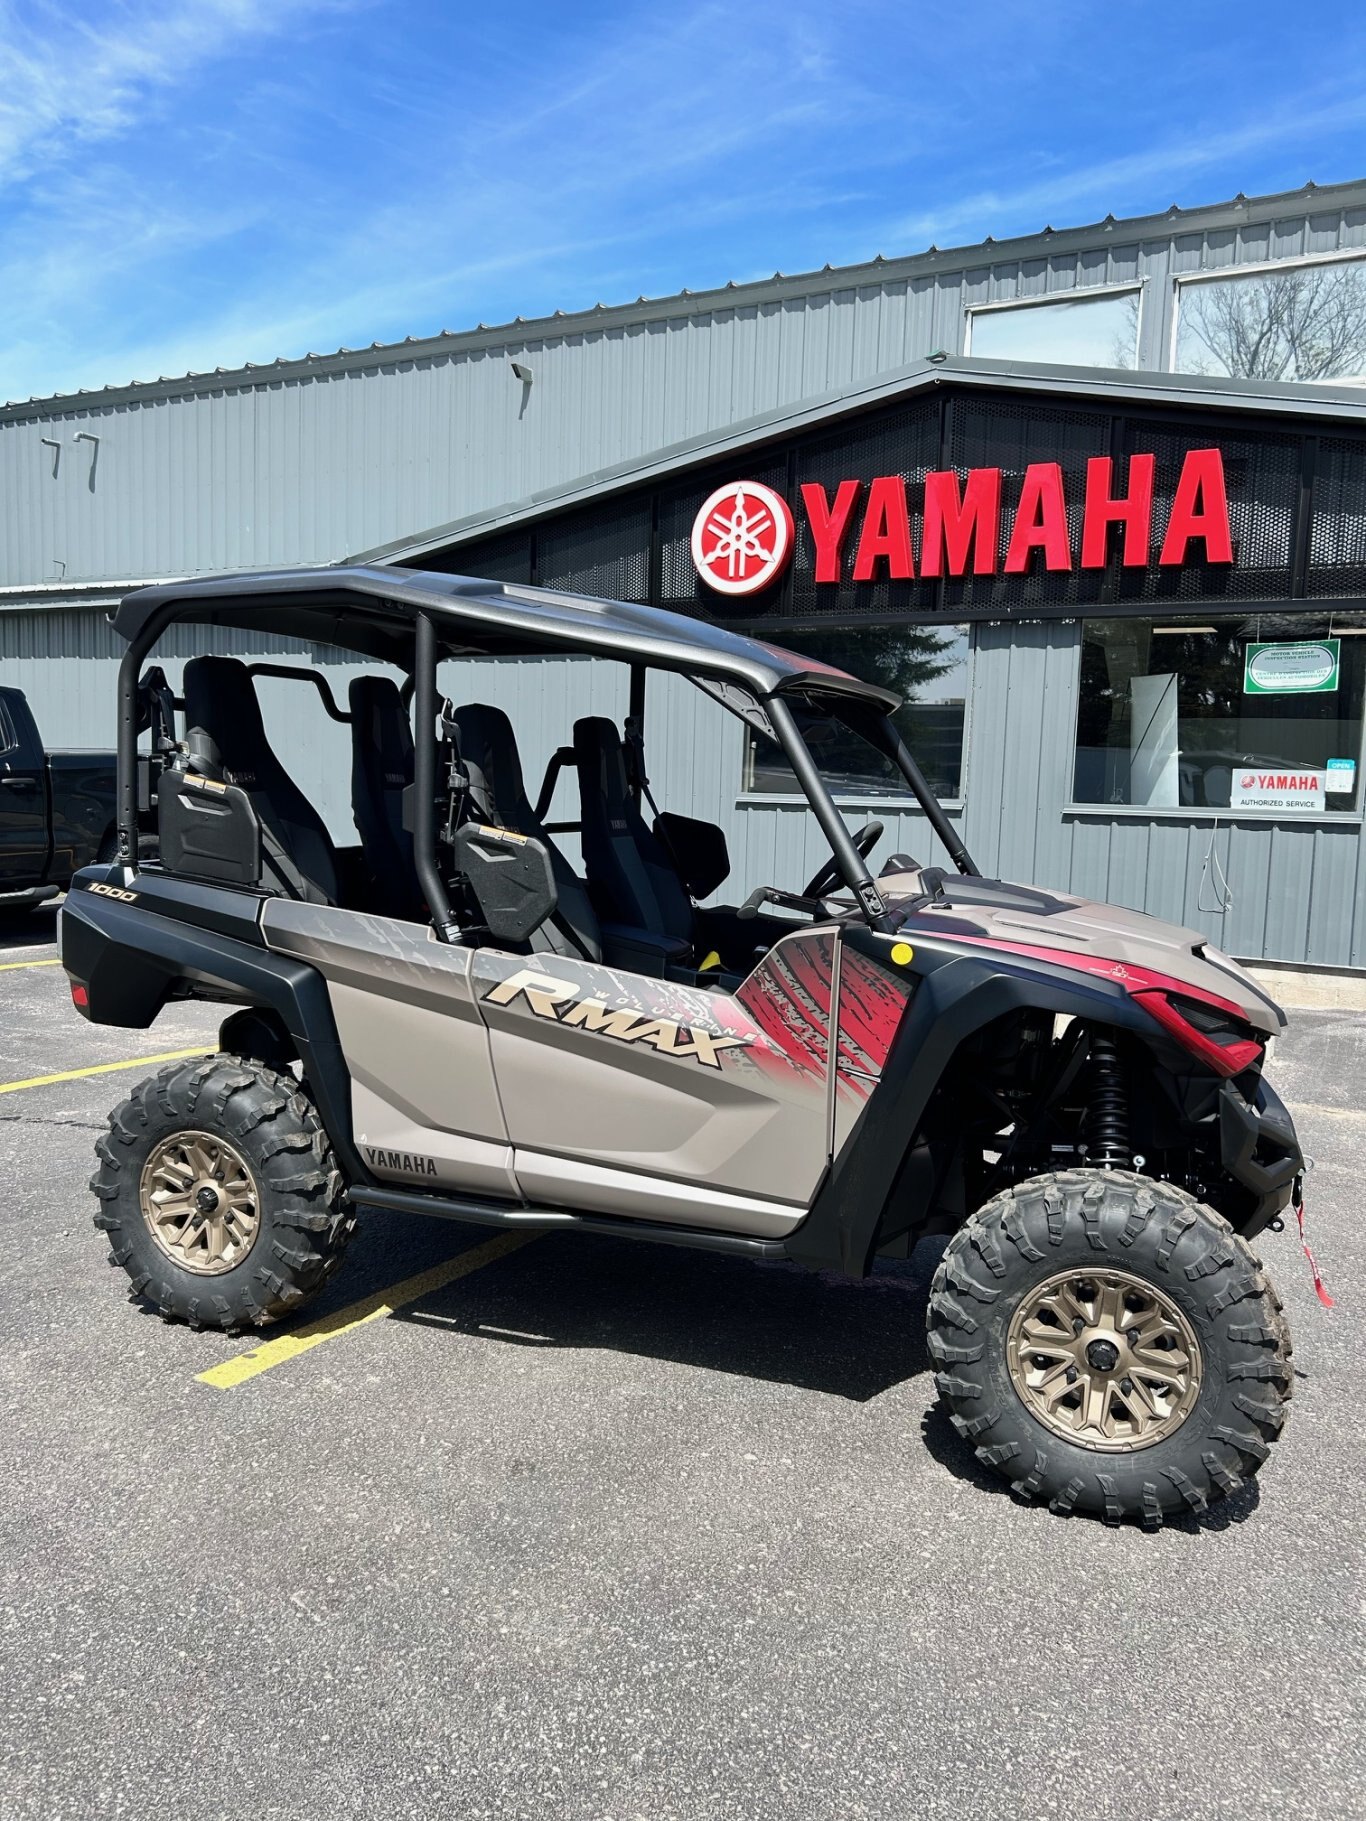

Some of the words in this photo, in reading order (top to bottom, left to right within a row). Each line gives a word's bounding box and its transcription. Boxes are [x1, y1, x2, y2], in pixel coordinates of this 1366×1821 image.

[800, 448, 1234, 583] YAMAHA
[1257, 775, 1319, 791] YAMAHA
[1240, 799, 1284, 807] AUTHORIZED
[1285, 800, 1316, 808] SERVICE
[87, 882, 139, 902] 1000
[482, 969, 752, 1068] RMAX
[365, 1147, 438, 1176] YAMAHA
